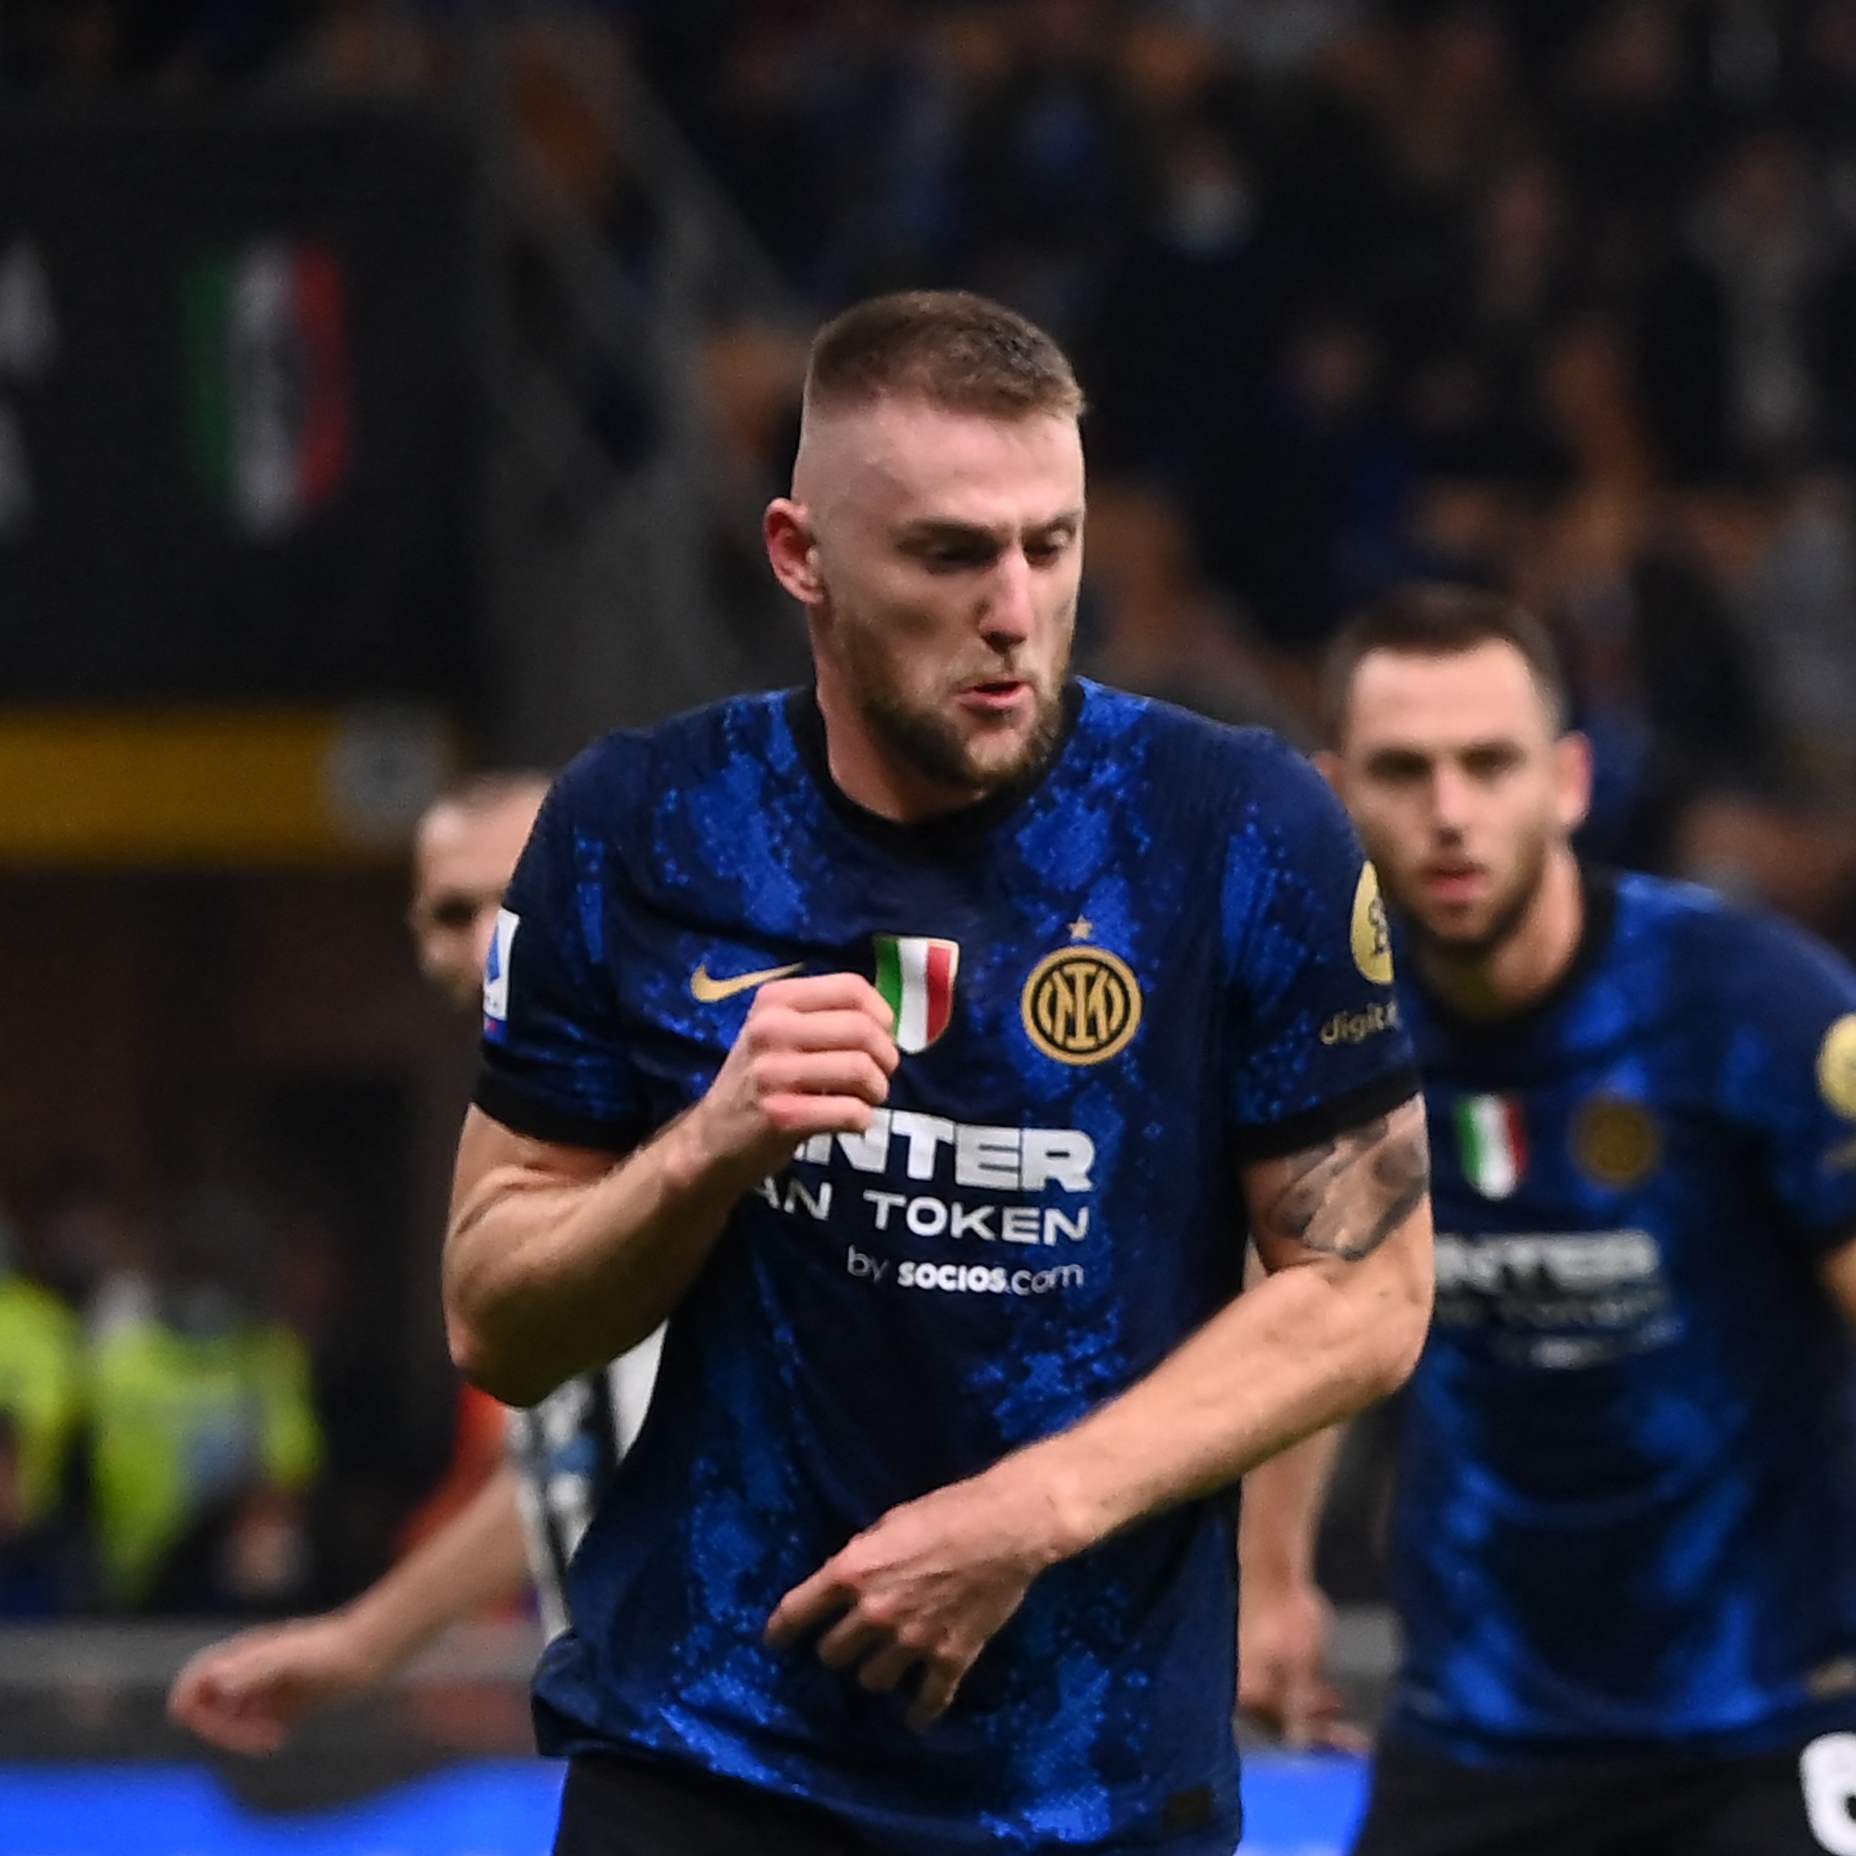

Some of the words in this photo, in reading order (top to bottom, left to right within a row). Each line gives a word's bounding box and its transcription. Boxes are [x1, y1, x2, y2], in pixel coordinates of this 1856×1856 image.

[793, 1106, 1096, 1193] NTER
[754, 1175, 833, 1222] AN
[862, 1189, 1090, 1247] TOKEN
[847, 1244, 890, 1284] by
[897, 1260, 1086, 1297] socios.com
